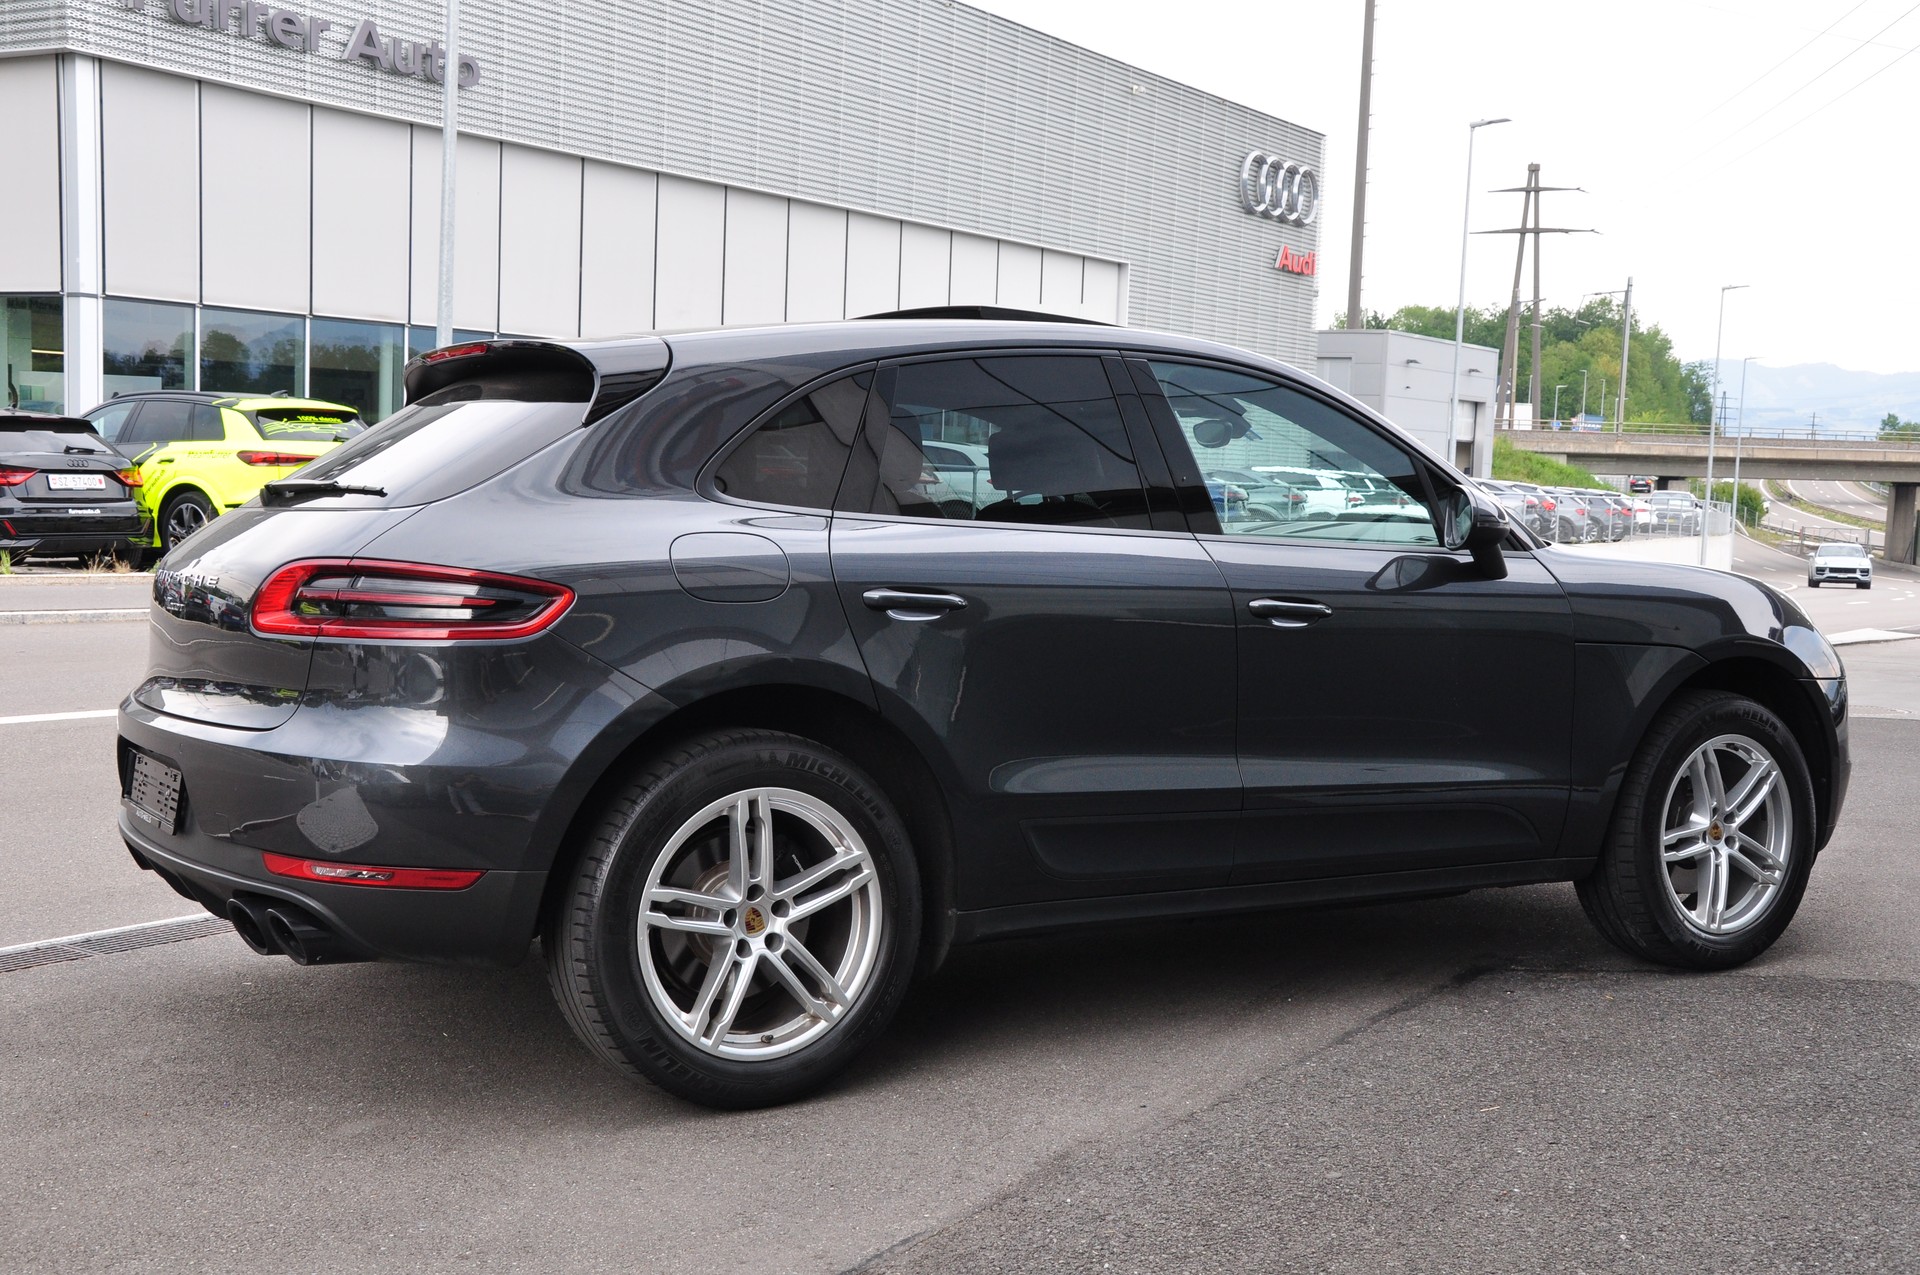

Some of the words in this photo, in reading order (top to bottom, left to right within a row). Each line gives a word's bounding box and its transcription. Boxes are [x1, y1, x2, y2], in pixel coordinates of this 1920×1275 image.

[127, 0, 331, 52] urrer
[342, 20, 481, 88] Auto
[1276, 244, 1316, 276] Audi
[784, 752, 886, 822] MICHELIN
